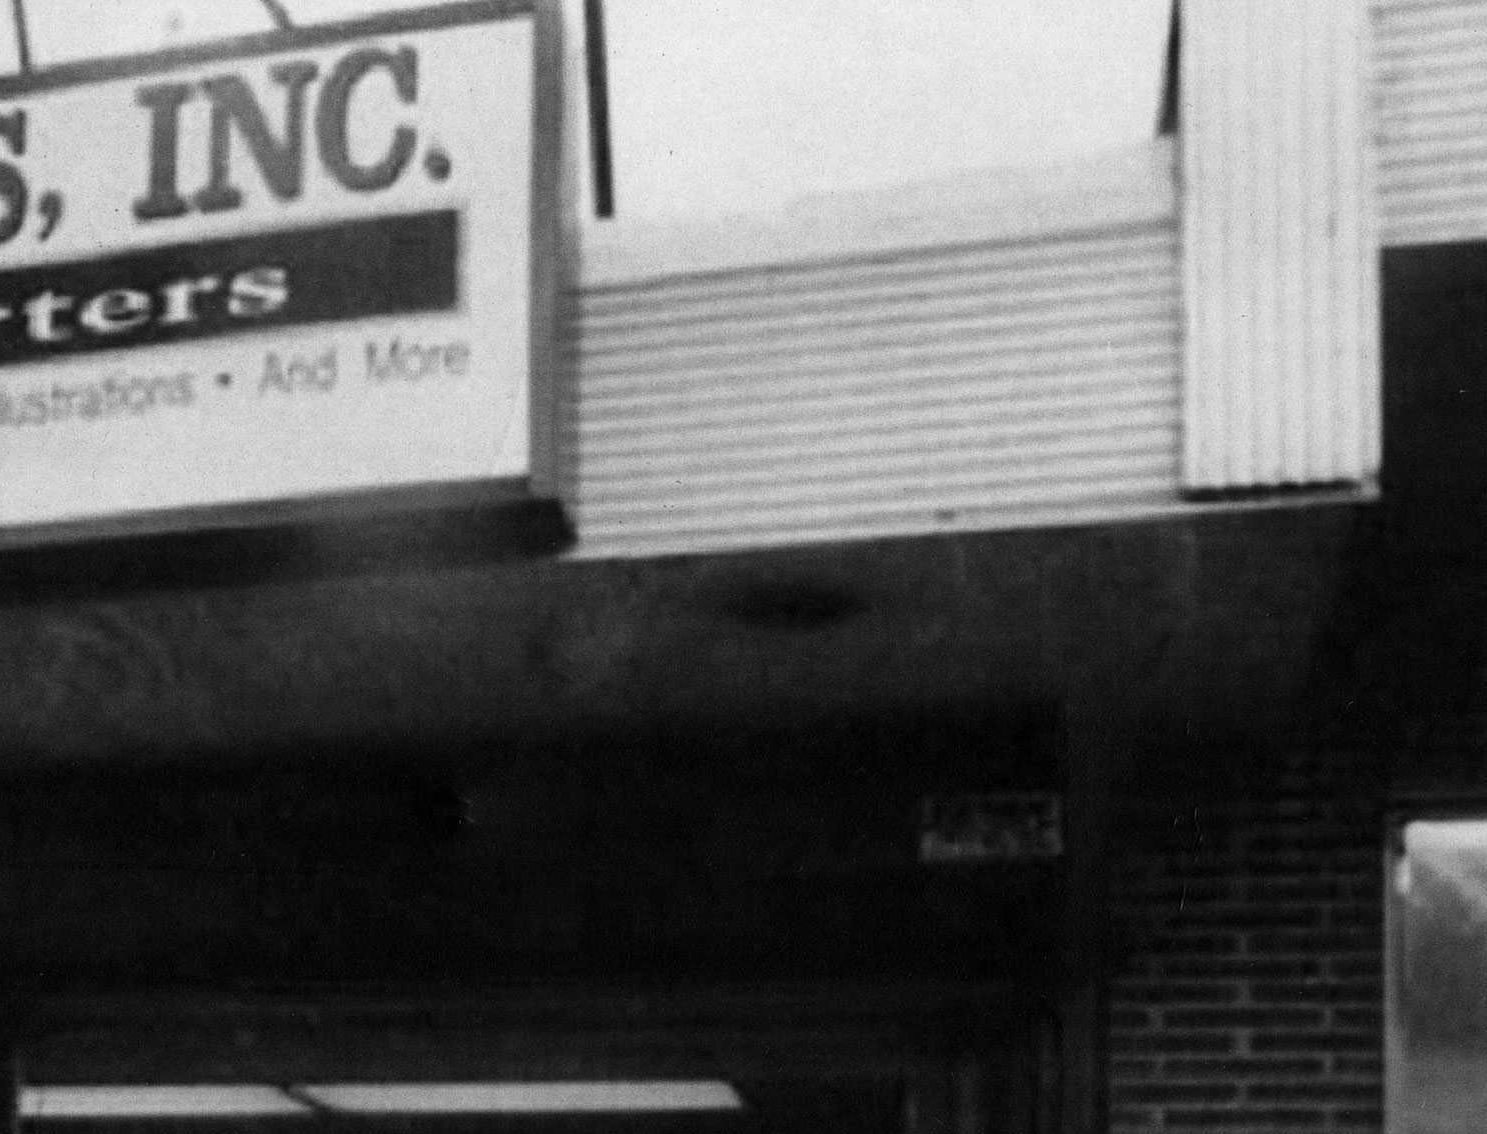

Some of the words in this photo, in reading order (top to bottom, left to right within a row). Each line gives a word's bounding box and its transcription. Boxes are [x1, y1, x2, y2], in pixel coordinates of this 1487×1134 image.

[131, 43, 454, 222] INC.
[258, 348, 339, 398] And
[365, 336, 471, 382] More
